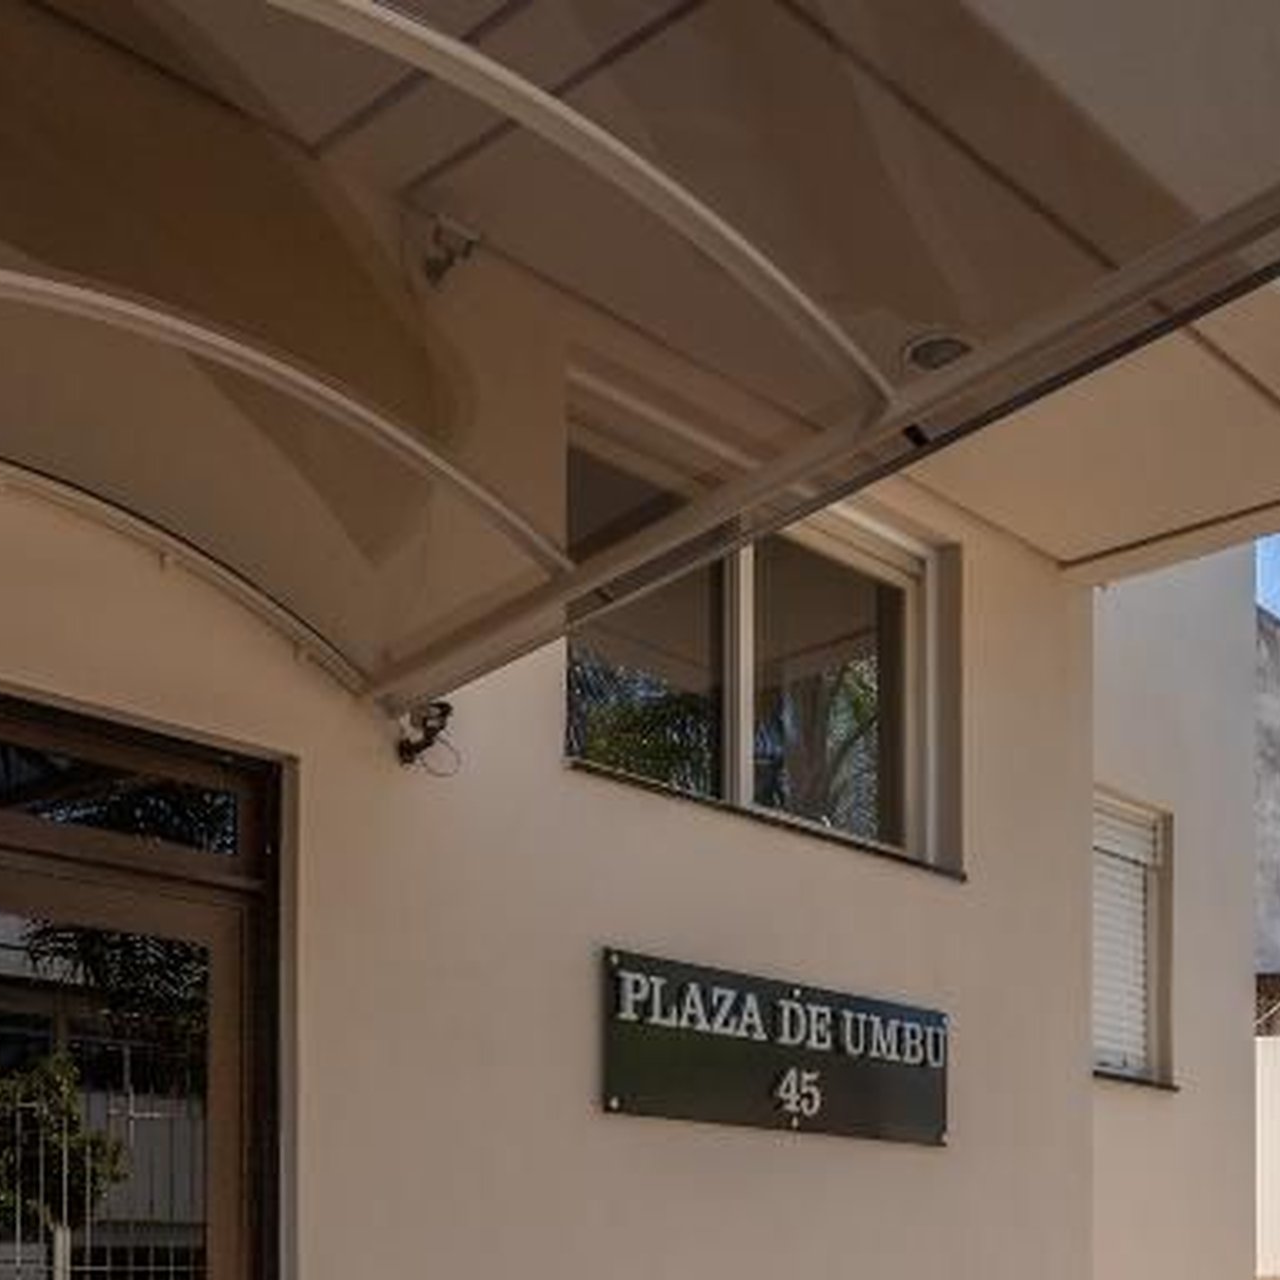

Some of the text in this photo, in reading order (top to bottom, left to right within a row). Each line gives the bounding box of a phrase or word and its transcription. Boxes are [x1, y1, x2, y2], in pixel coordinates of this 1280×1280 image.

[616, 970, 948, 1068] PLAZA DE UMBU
[777, 1066, 821, 1117] 45
